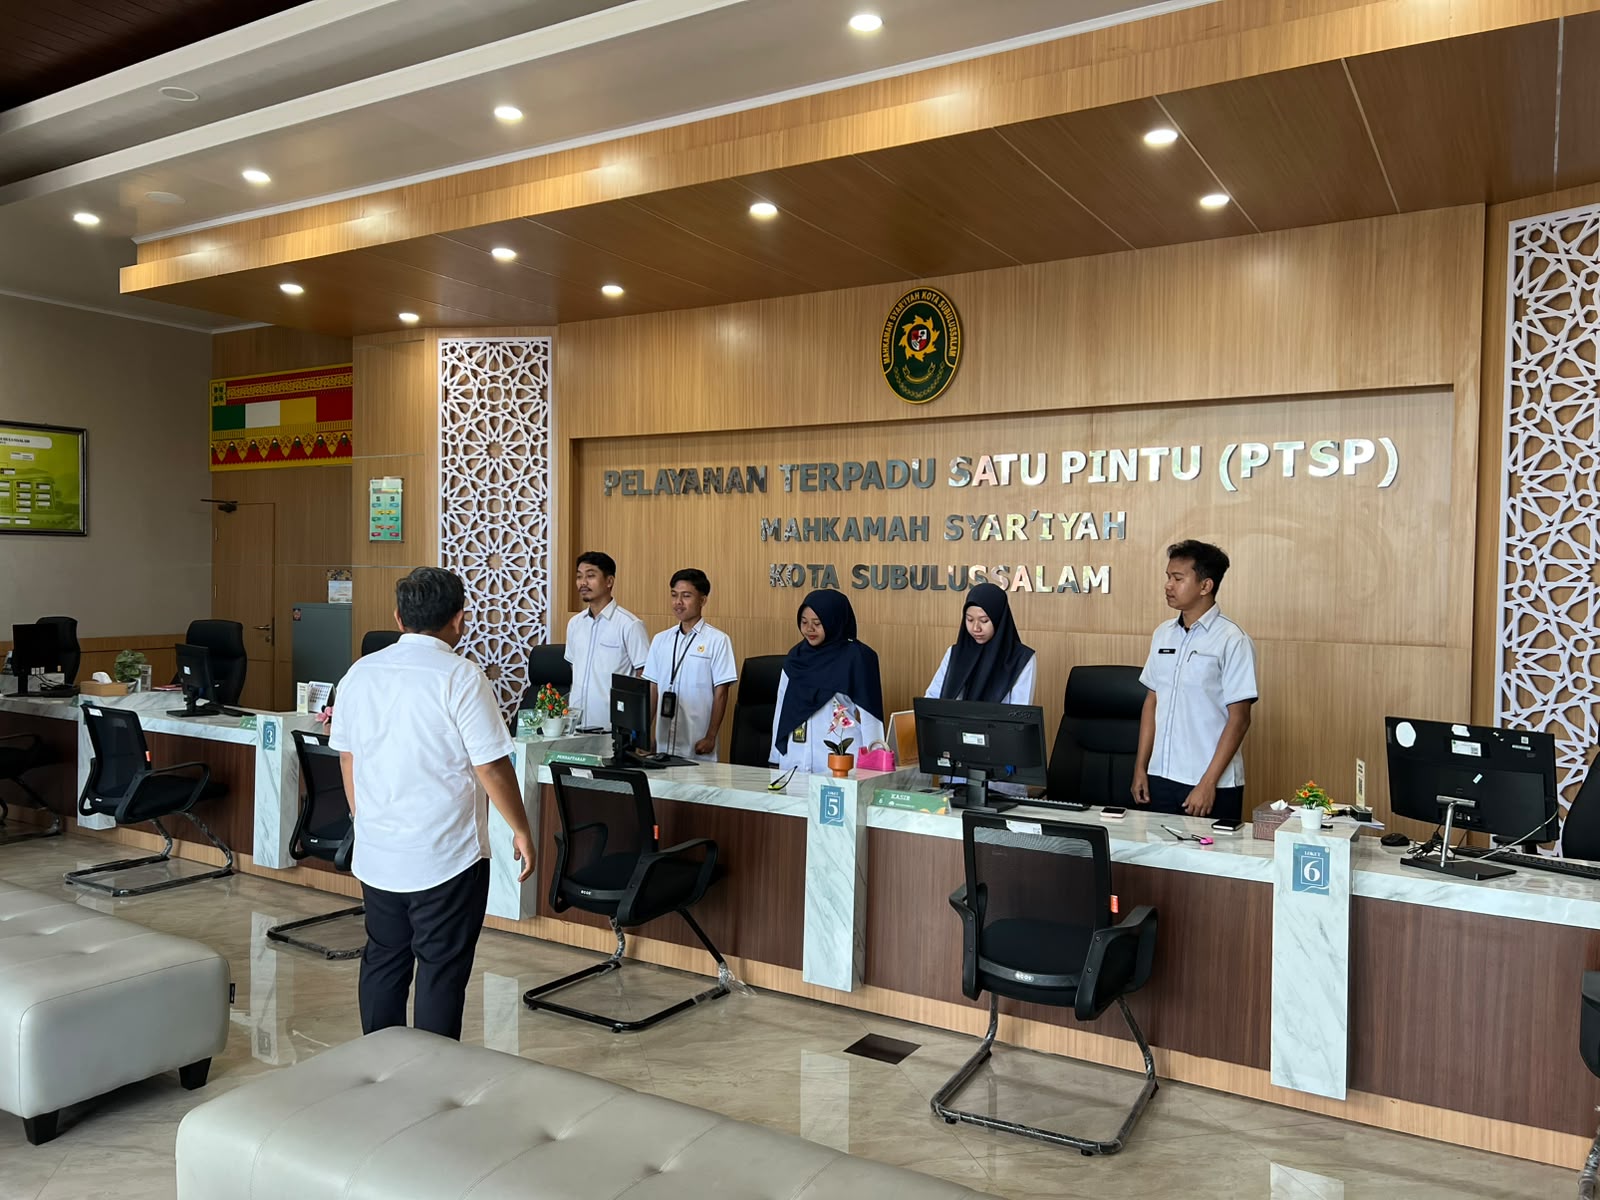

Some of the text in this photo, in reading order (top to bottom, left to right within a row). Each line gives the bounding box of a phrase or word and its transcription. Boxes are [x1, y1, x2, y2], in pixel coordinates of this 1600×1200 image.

[921, 291, 940, 305] KOTA
[604, 437, 1399, 496] PELAYANAN TERPADU SATU PINTU (PTSP)
[760, 509, 1126, 542] MAHKAMAH SYAR'IYAH
[769, 563, 1111, 593] KOTA SUBULUSSALAM
[267, 730, 273, 743] 3
[890, 793, 911, 801] KASIR
[827, 798, 839, 817] 5
[1303, 860, 1321, 882] 6
